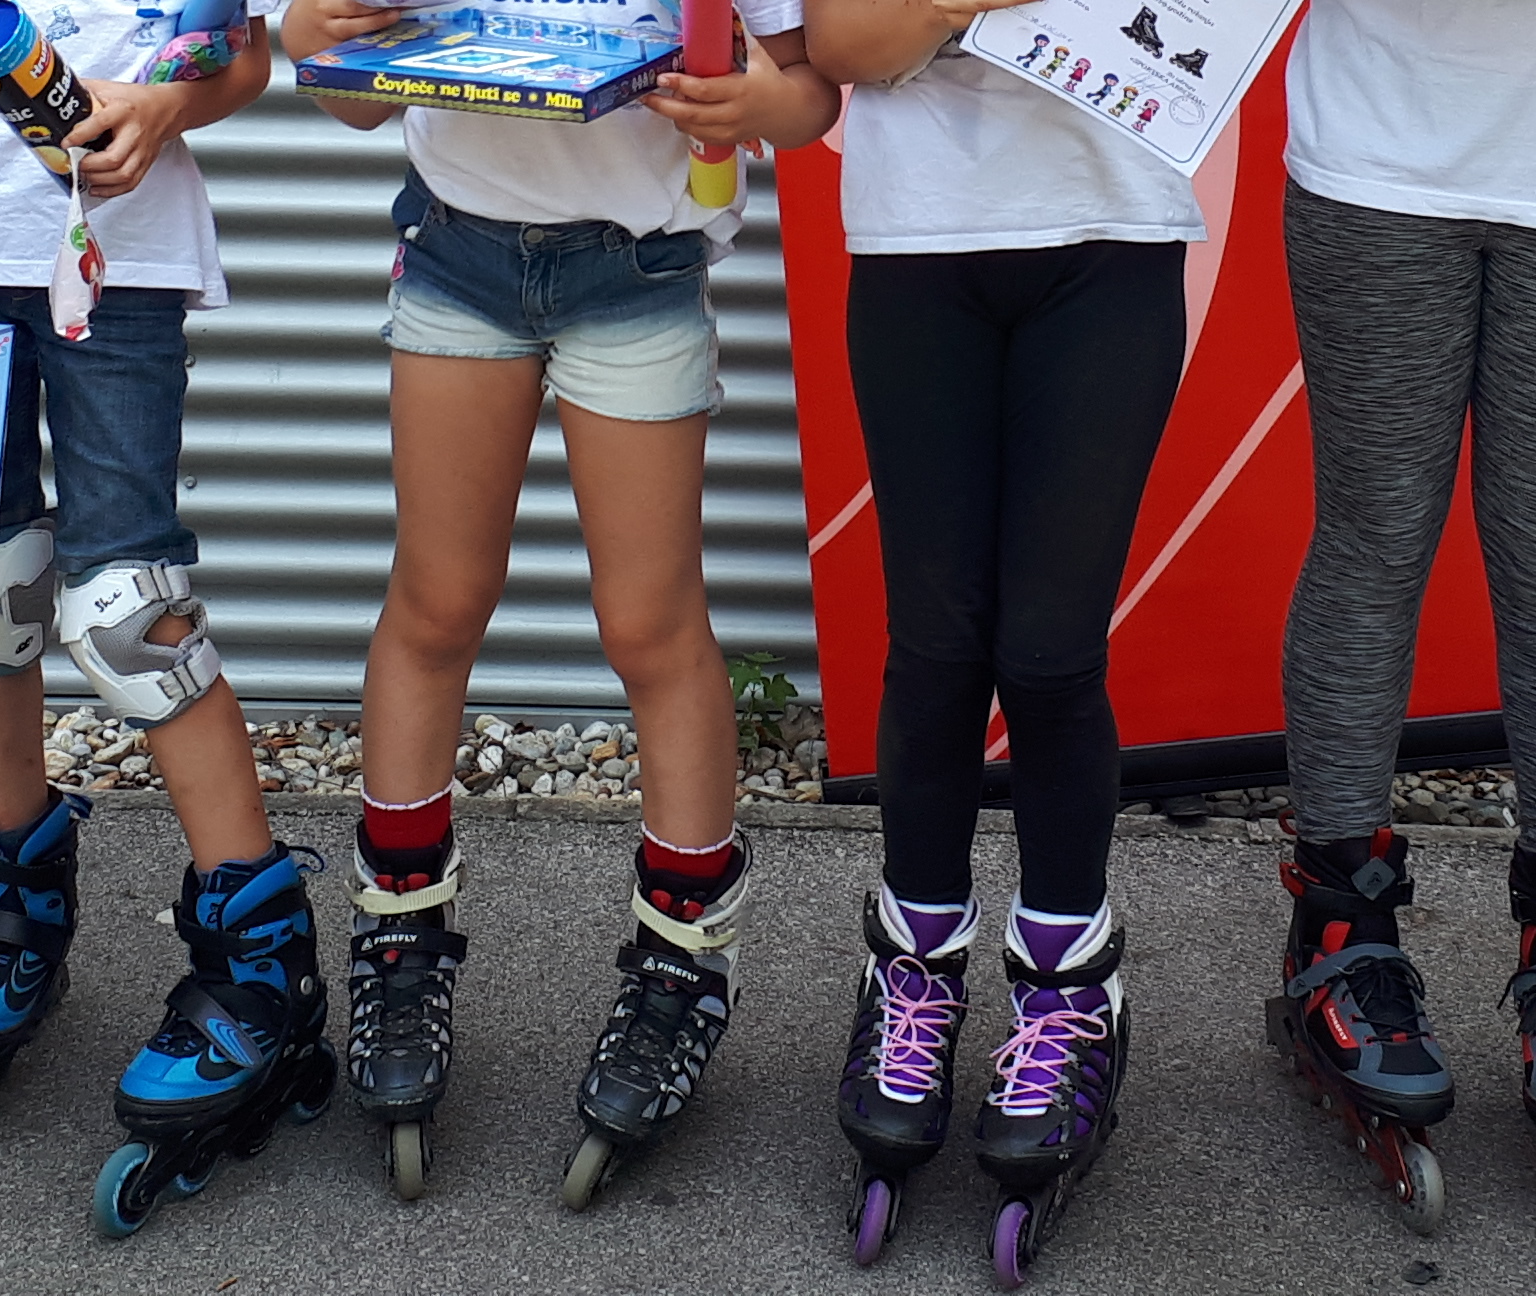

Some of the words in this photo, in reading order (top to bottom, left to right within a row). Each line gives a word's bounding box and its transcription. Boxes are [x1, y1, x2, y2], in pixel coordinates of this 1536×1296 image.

[372, 72, 436, 95] Čovječe
[440, 84, 461, 97] ne
[463, 84, 500, 102] ljuti
[502, 90, 522, 103] se
[545, 91, 584, 110] Mlin
[373, 933, 418, 945] FIREFLY
[657, 961, 700, 984] FIREFLY
